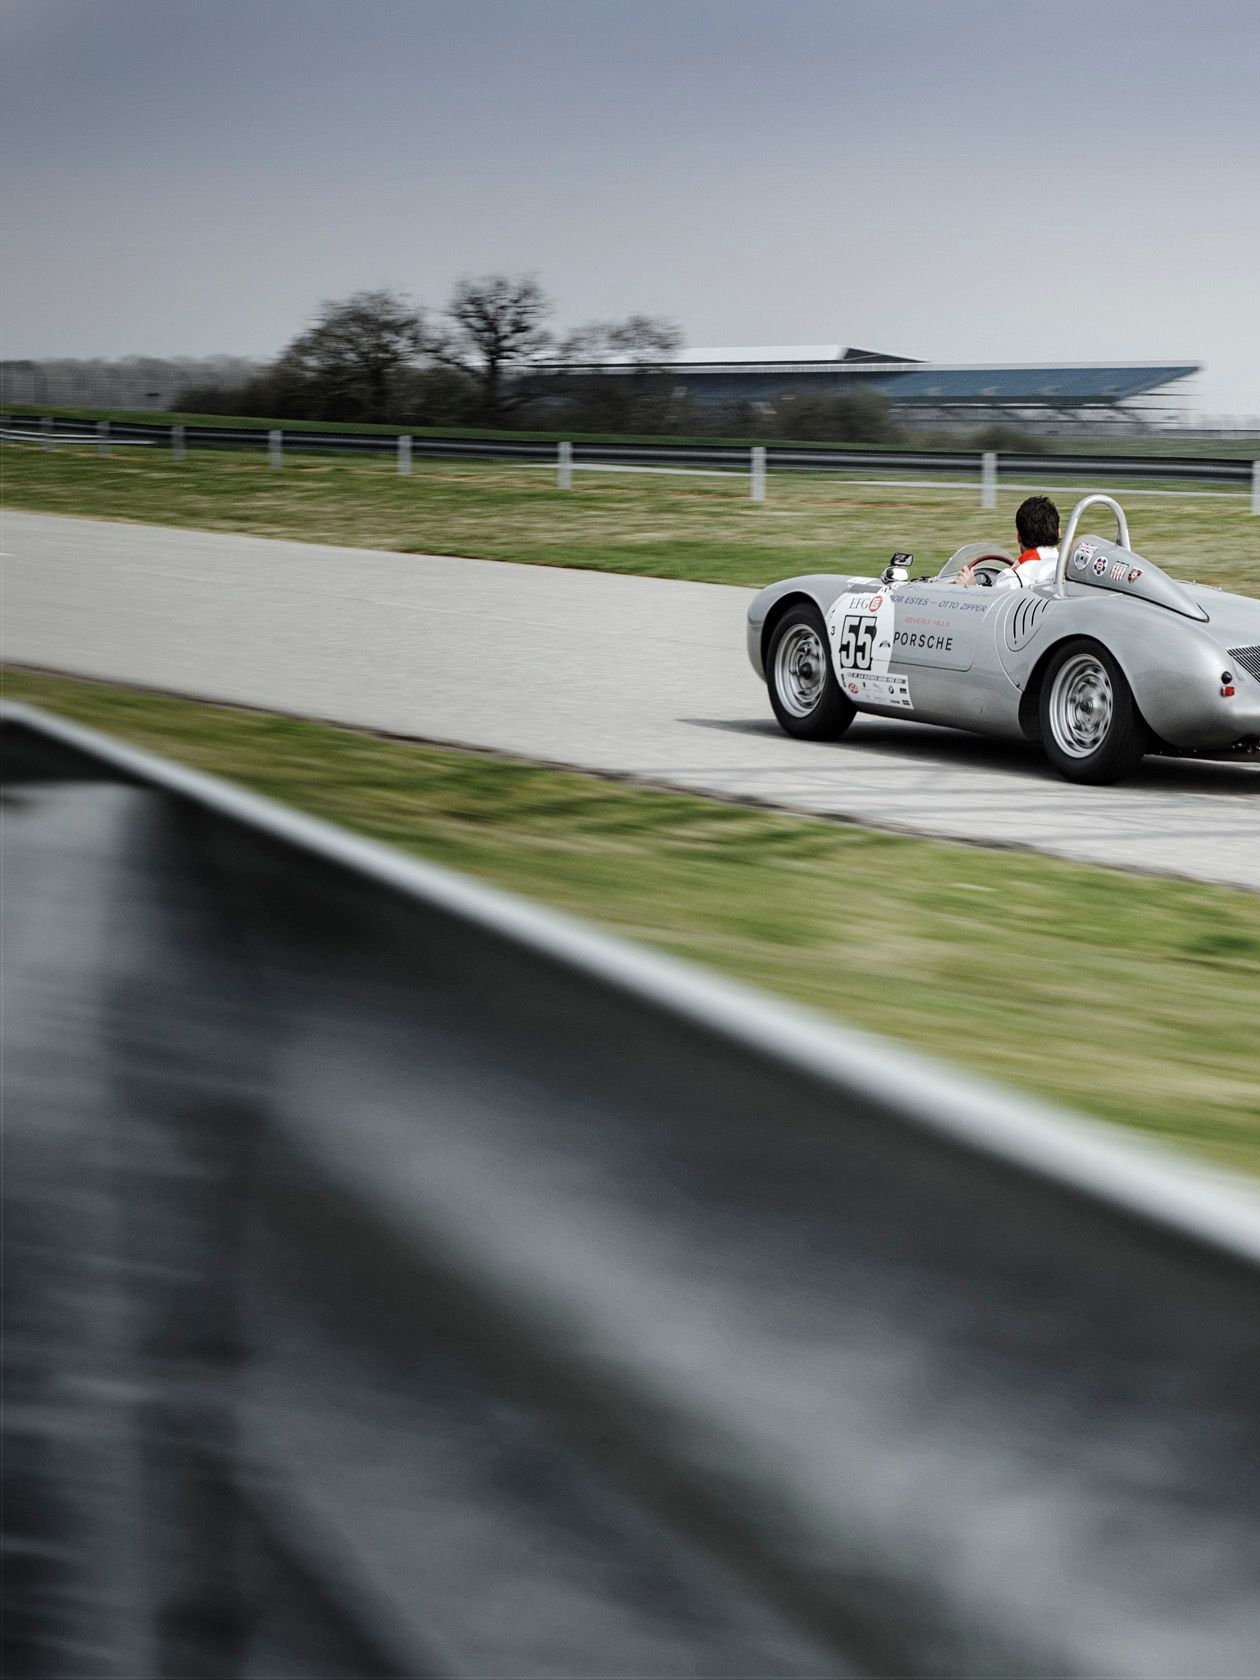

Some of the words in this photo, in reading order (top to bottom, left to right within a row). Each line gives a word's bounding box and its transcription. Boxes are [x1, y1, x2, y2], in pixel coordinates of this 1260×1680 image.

[905, 596, 930, 606] ESTES
[939, 600, 960, 609] OTTO
[840, 615, 877, 671] 55
[893, 631, 953, 651] PORSCHE
